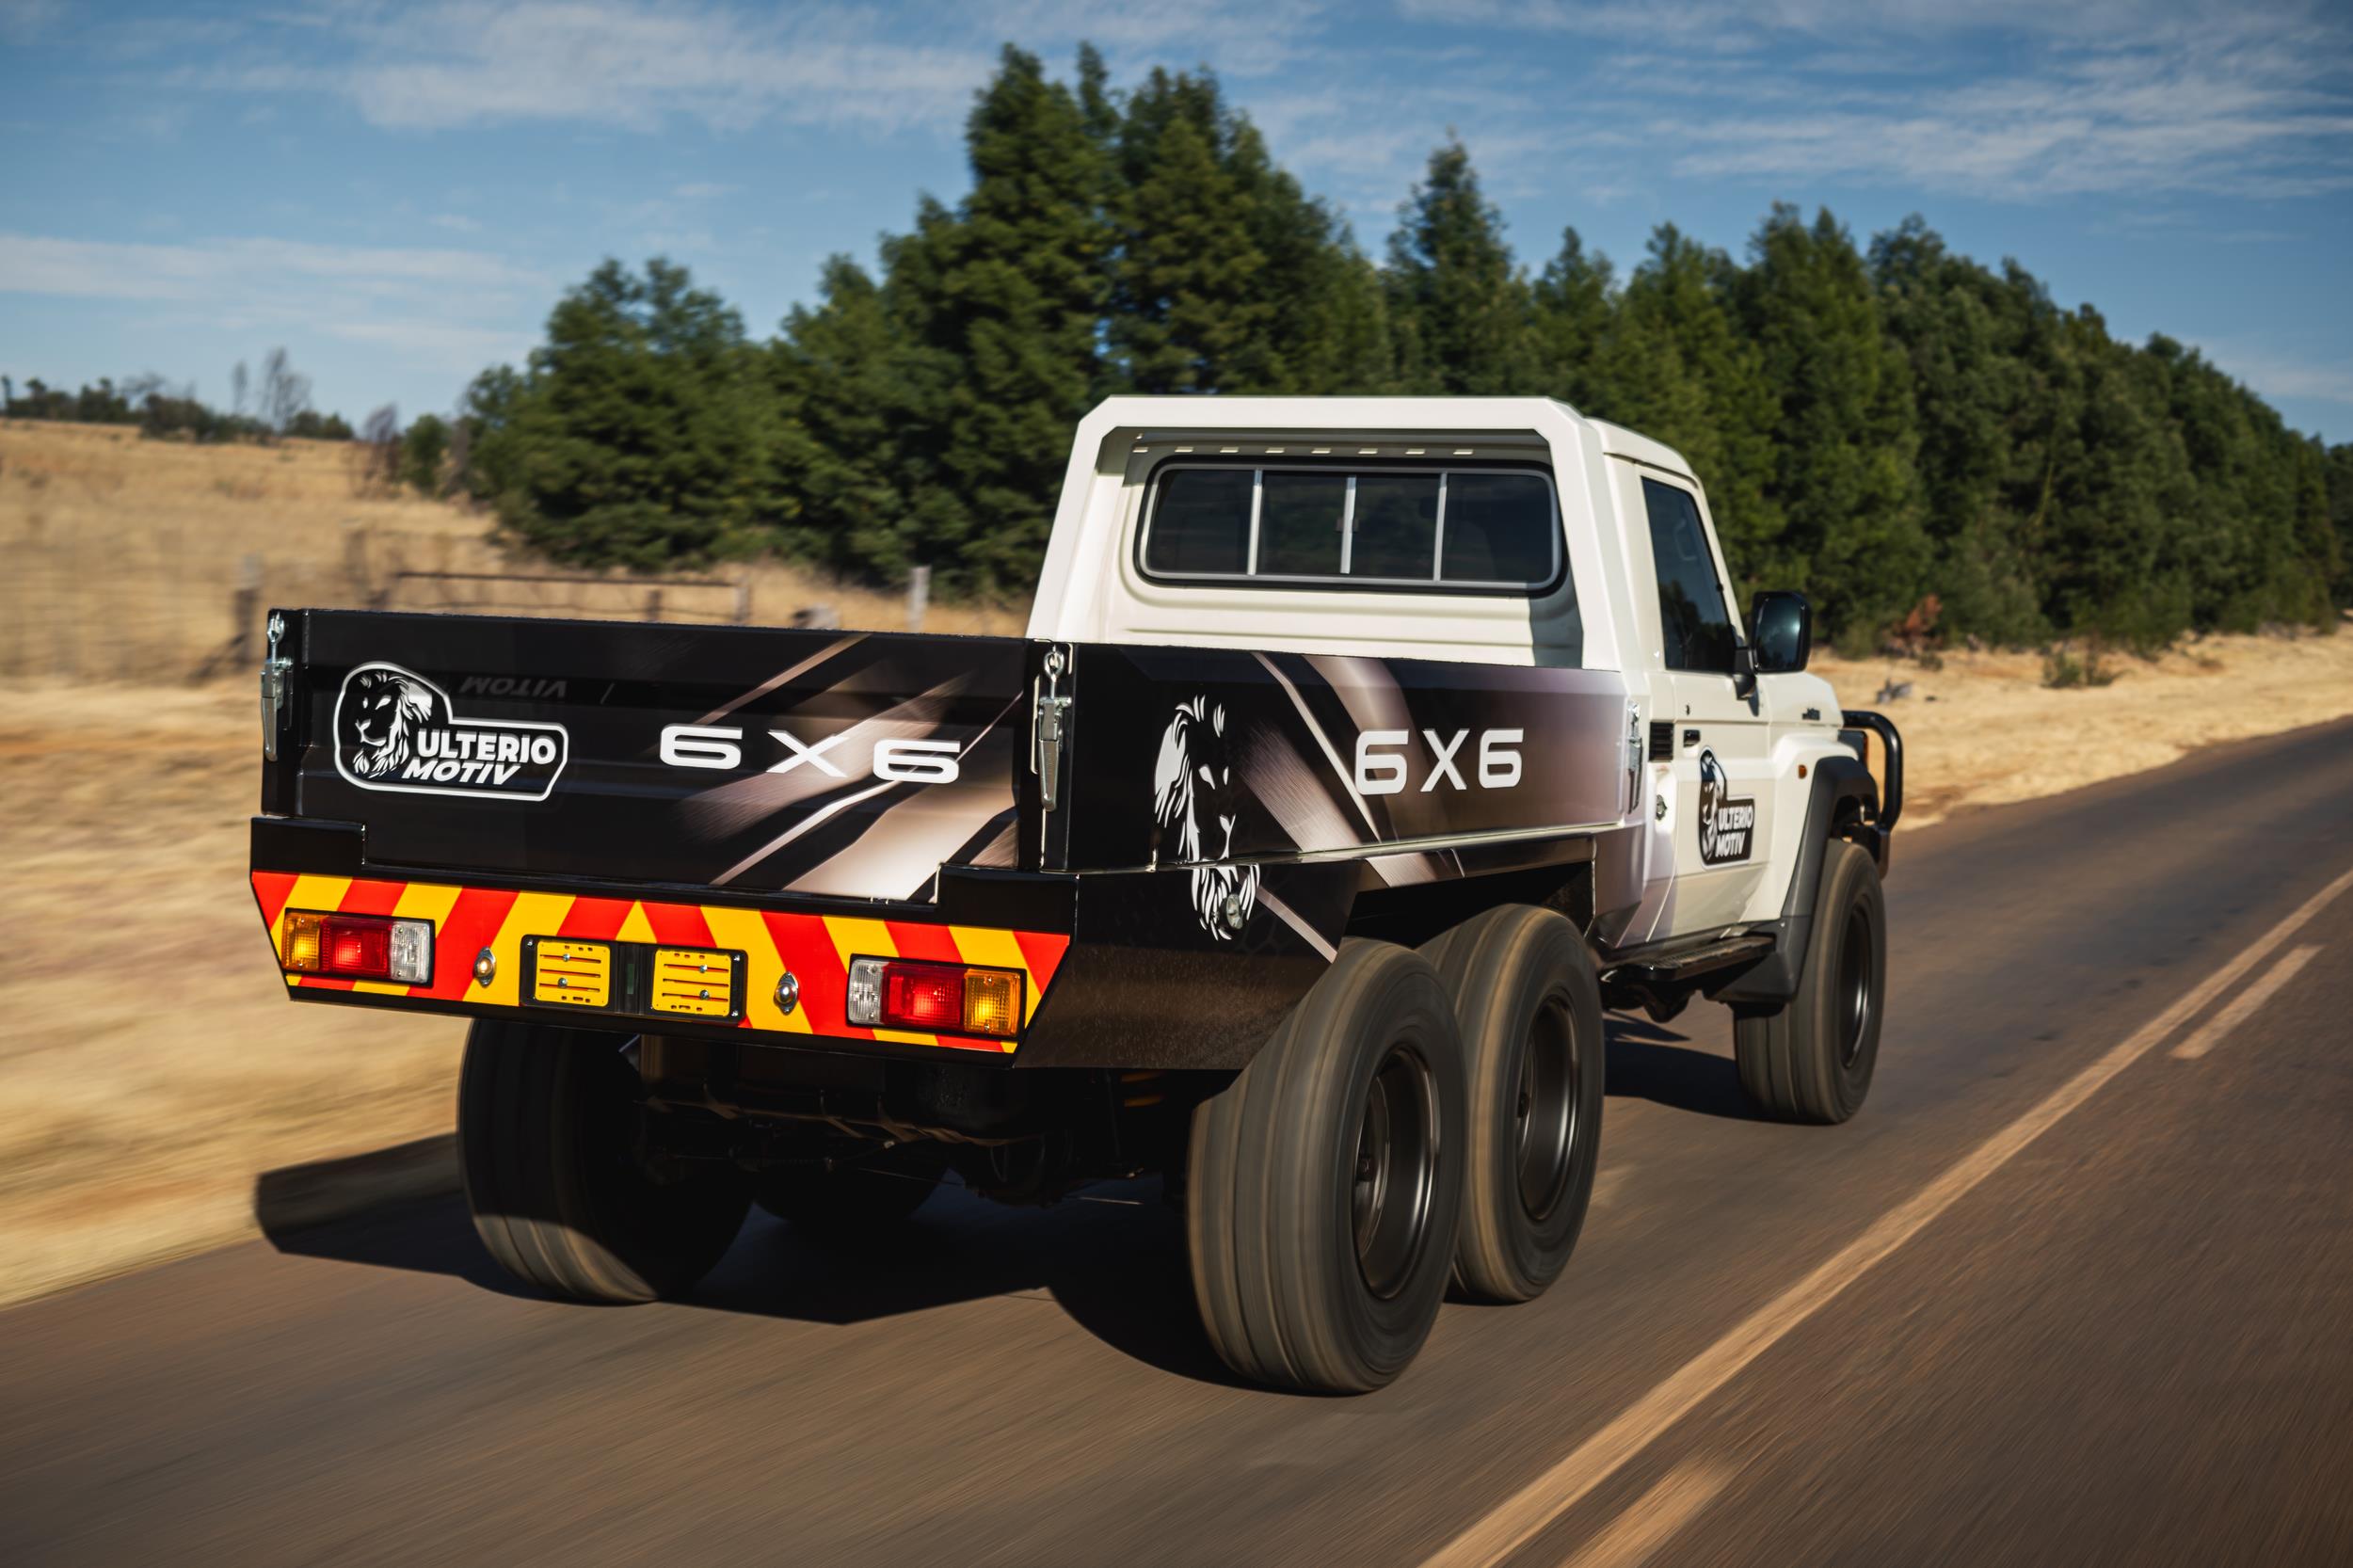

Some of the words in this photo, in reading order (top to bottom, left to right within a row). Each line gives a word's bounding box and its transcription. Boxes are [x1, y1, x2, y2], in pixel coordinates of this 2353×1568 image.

[417, 728, 557, 765] ULTERIO
[401, 757, 521, 786] MOTIV
[1353, 728, 1525, 795] 6X6
[1718, 805, 1753, 831] ULTERIO
[1715, 832, 1746, 857] MOTIV
